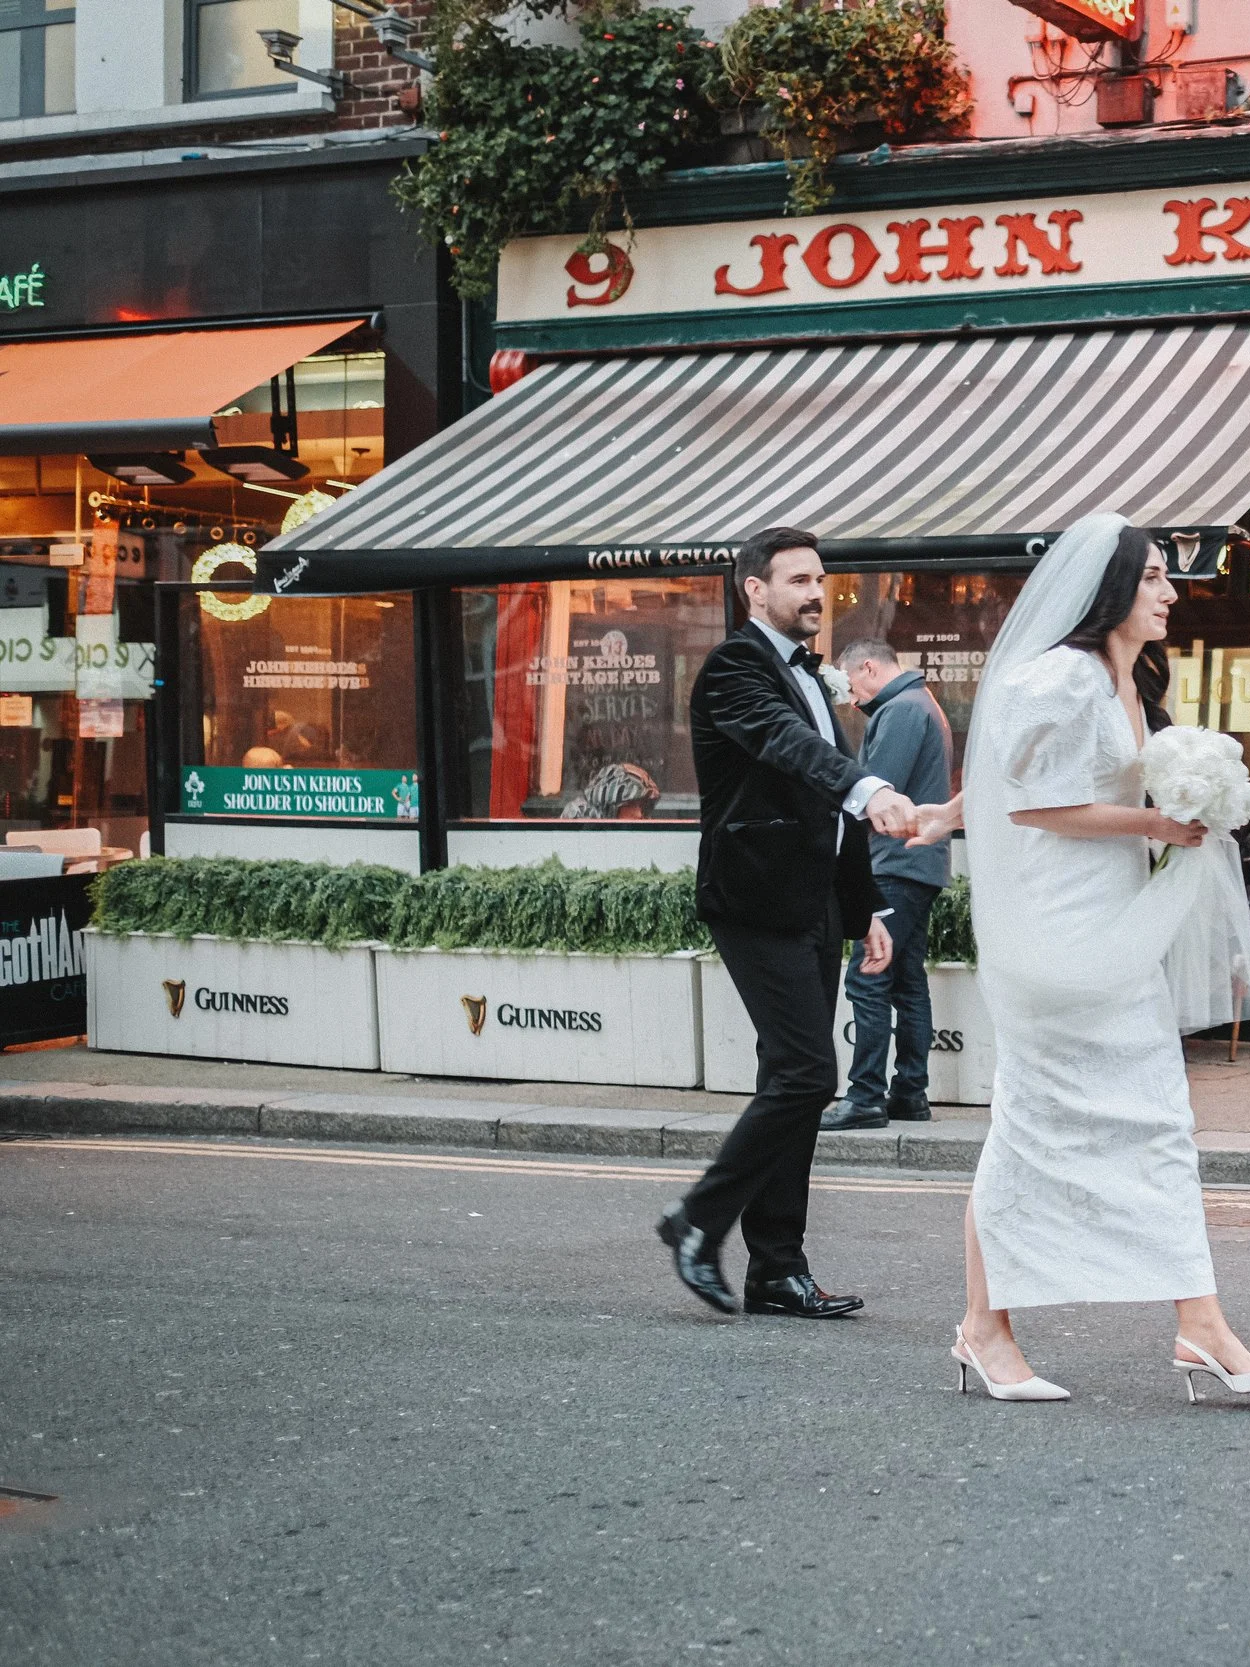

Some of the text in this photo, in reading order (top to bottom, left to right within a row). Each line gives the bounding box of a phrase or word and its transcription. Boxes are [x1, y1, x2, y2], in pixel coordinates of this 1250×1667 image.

[565, 243, 634, 308] 9
[714, 209, 1082, 296] JOHN
[0, 263, 45, 308] AFÉ
[917, 634, 934, 642] EST
[927, 652, 989, 666] KEHO
[622, 671, 661, 684] PUB
[242, 774, 362, 794] JOIN US IN KEHOES
[223, 793, 385, 814] SHOULDER TO SHOULDER
[194, 987, 289, 1015] GUINNESS
[497, 1003, 602, 1032] GUINNESS
